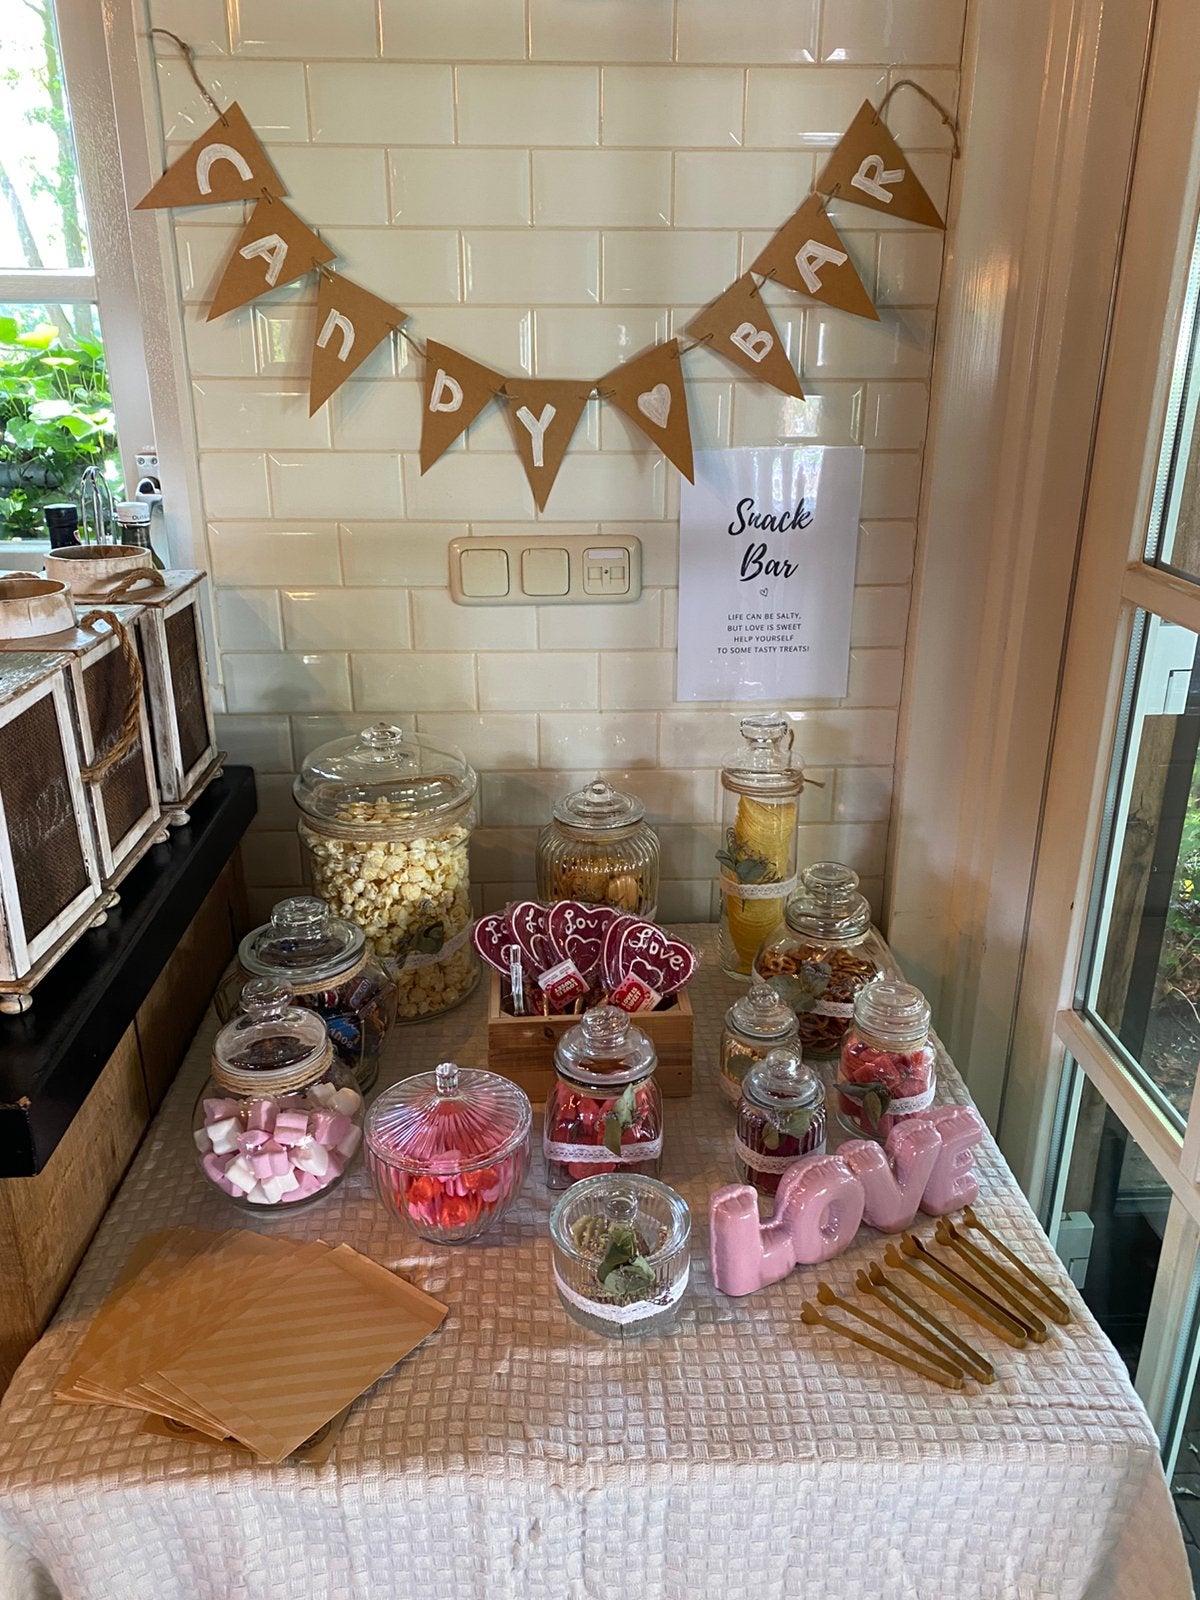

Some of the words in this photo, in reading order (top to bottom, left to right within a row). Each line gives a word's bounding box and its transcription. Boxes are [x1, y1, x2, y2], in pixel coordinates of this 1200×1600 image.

[729, 154, 906, 363] BAR
[728, 497, 814, 536] Snack
[739, 542, 800, 582] Bar
[727, 613, 744, 621] LIFE
[776, 612, 802, 620] SALTY,
[727, 624, 743, 632] BUT
[745, 624, 765, 632] LOVE
[776, 623, 802, 631] SWEET
[729, 646, 751, 654] SOME
[779, 645, 810, 653] TREATS!
[755, 634, 794, 642] YOURSELF
[485, 920, 509, 945] Lo
[628, 928, 684, 971] Love
[709, 1105, 983, 1297] LOVE
